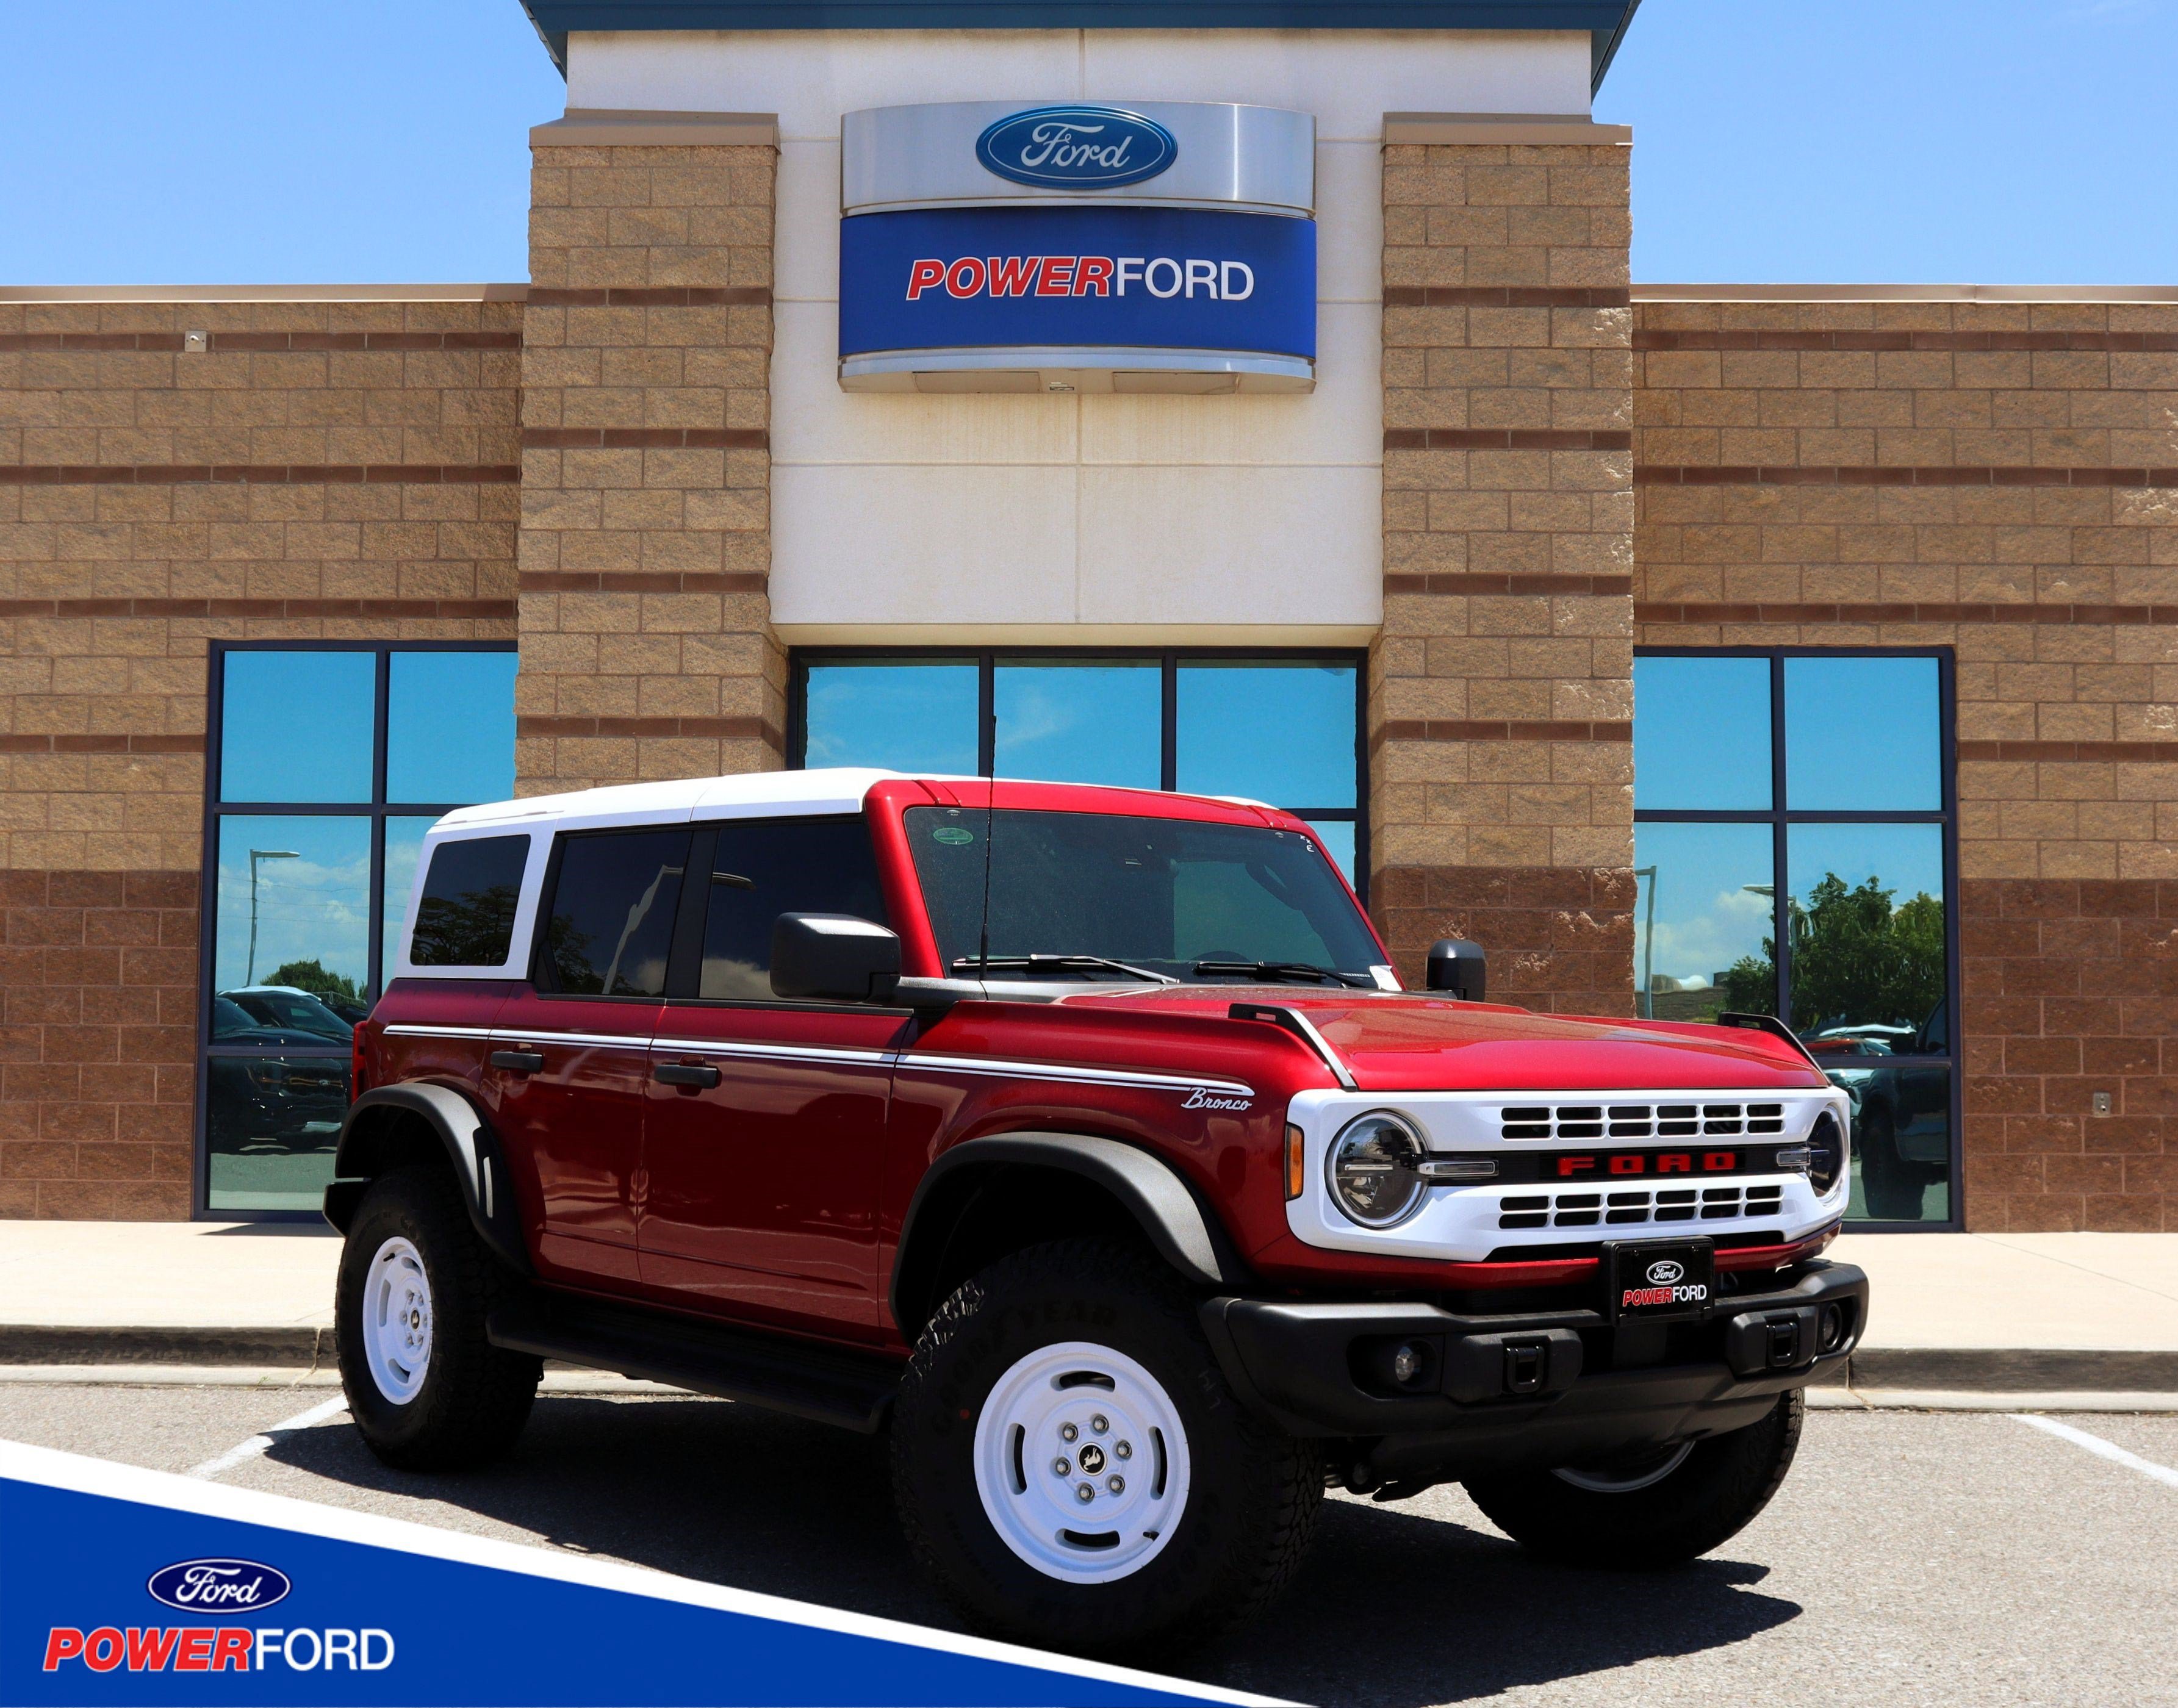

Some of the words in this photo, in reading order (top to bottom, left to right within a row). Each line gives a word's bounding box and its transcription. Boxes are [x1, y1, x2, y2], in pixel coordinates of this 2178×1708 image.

[1020, 122, 1133, 168] Ford
[906, 256, 1255, 301] POWERFORD
[1181, 1087, 1252, 1111] Bronco
[1557, 1152, 1736, 1176] FORD
[1653, 1265, 1676, 1280] Ford
[1622, 1285, 1707, 1307] POWERFORD
